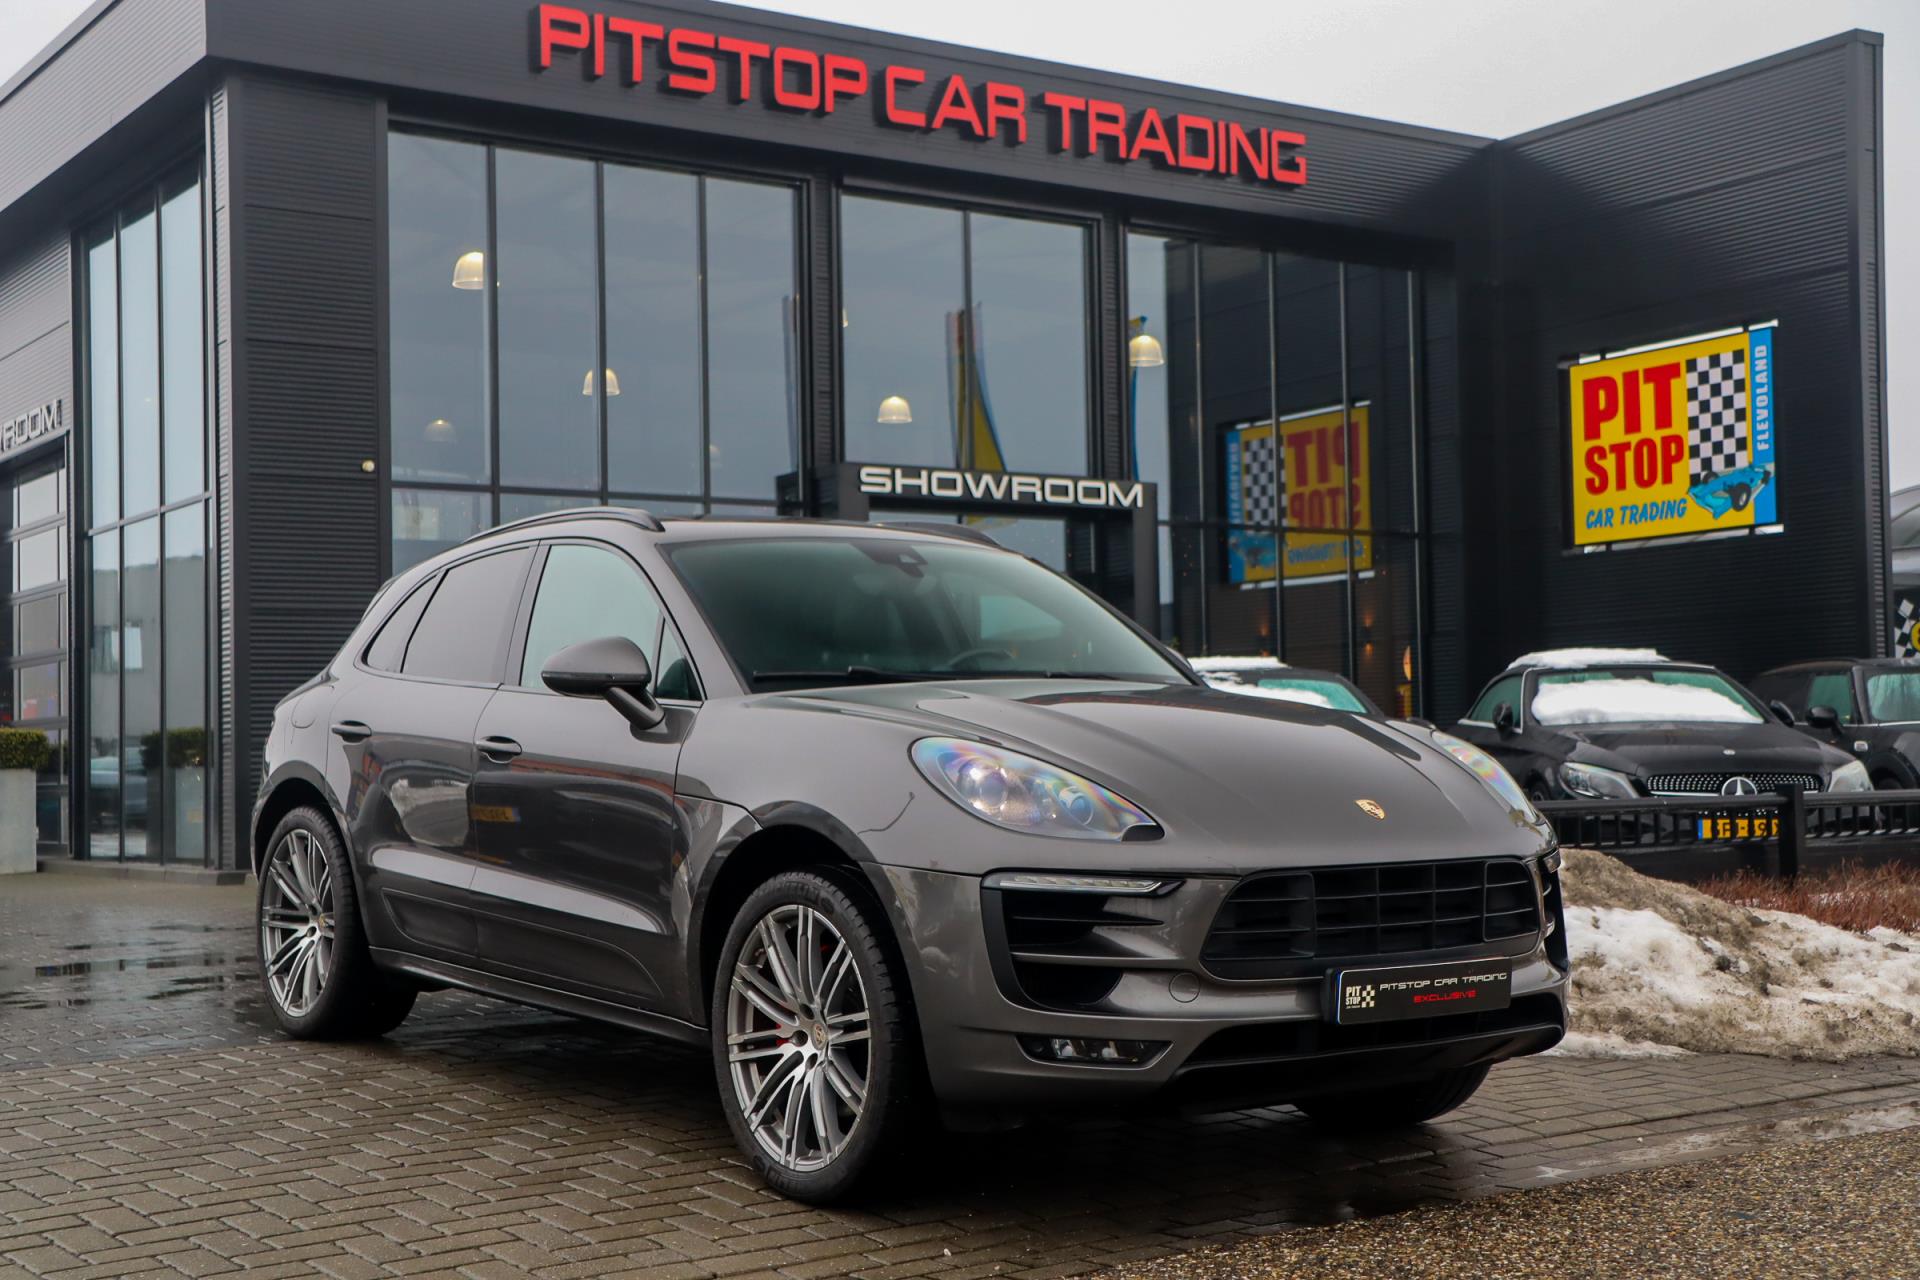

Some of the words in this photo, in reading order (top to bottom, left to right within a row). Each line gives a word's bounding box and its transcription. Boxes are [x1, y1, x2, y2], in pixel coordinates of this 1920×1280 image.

[538, 2, 869, 114] PITSTOP
[885, 64, 1028, 144] CAR
[1044, 90, 1309, 186] TRADING
[1582, 362, 1681, 441] PIT
[1754, 345, 1770, 451] FLEVOLAND
[1584, 434, 1685, 495] STOP
[860, 466, 1143, 508] SHOWROOM
[1586, 508, 1615, 529] CAR
[1620, 498, 1687, 525] TRADING
[1345, 985, 1362, 997] PIT
[1379, 980, 1430, 991] PITSTOP
[1434, 977, 1458, 987] CAR
[1462, 972, 1507, 984] TRADING
[1413, 989, 1477, 1003] EXCLUSIVE
[1345, 997, 1361, 1006] STOP
